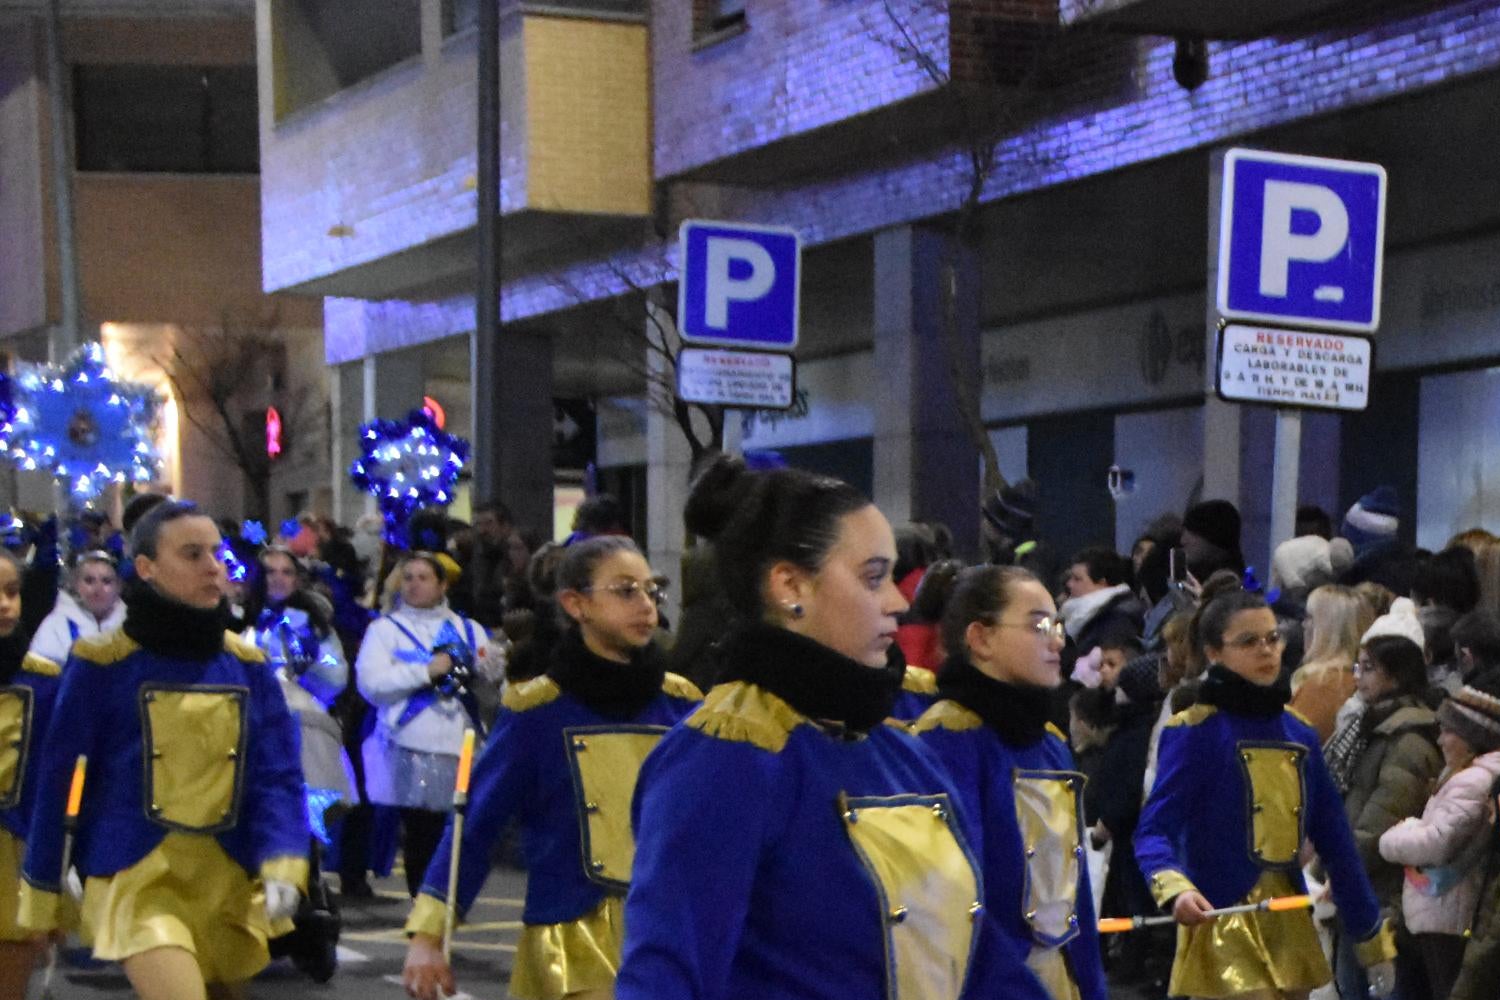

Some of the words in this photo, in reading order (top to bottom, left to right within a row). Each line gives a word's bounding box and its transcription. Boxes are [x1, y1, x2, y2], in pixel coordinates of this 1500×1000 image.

[1259, 179, 1350, 299] P
[705, 237, 775, 330] P
[1256, 332, 1344, 352] RESERVADO
[1234, 343, 1276, 356] CARGA
[1284, 348, 1290, 357] Y
[1298, 349, 1363, 365] DESCARGA
[1248, 359, 1326, 375] LABORABLES
[1333, 366, 1348, 378] DE
